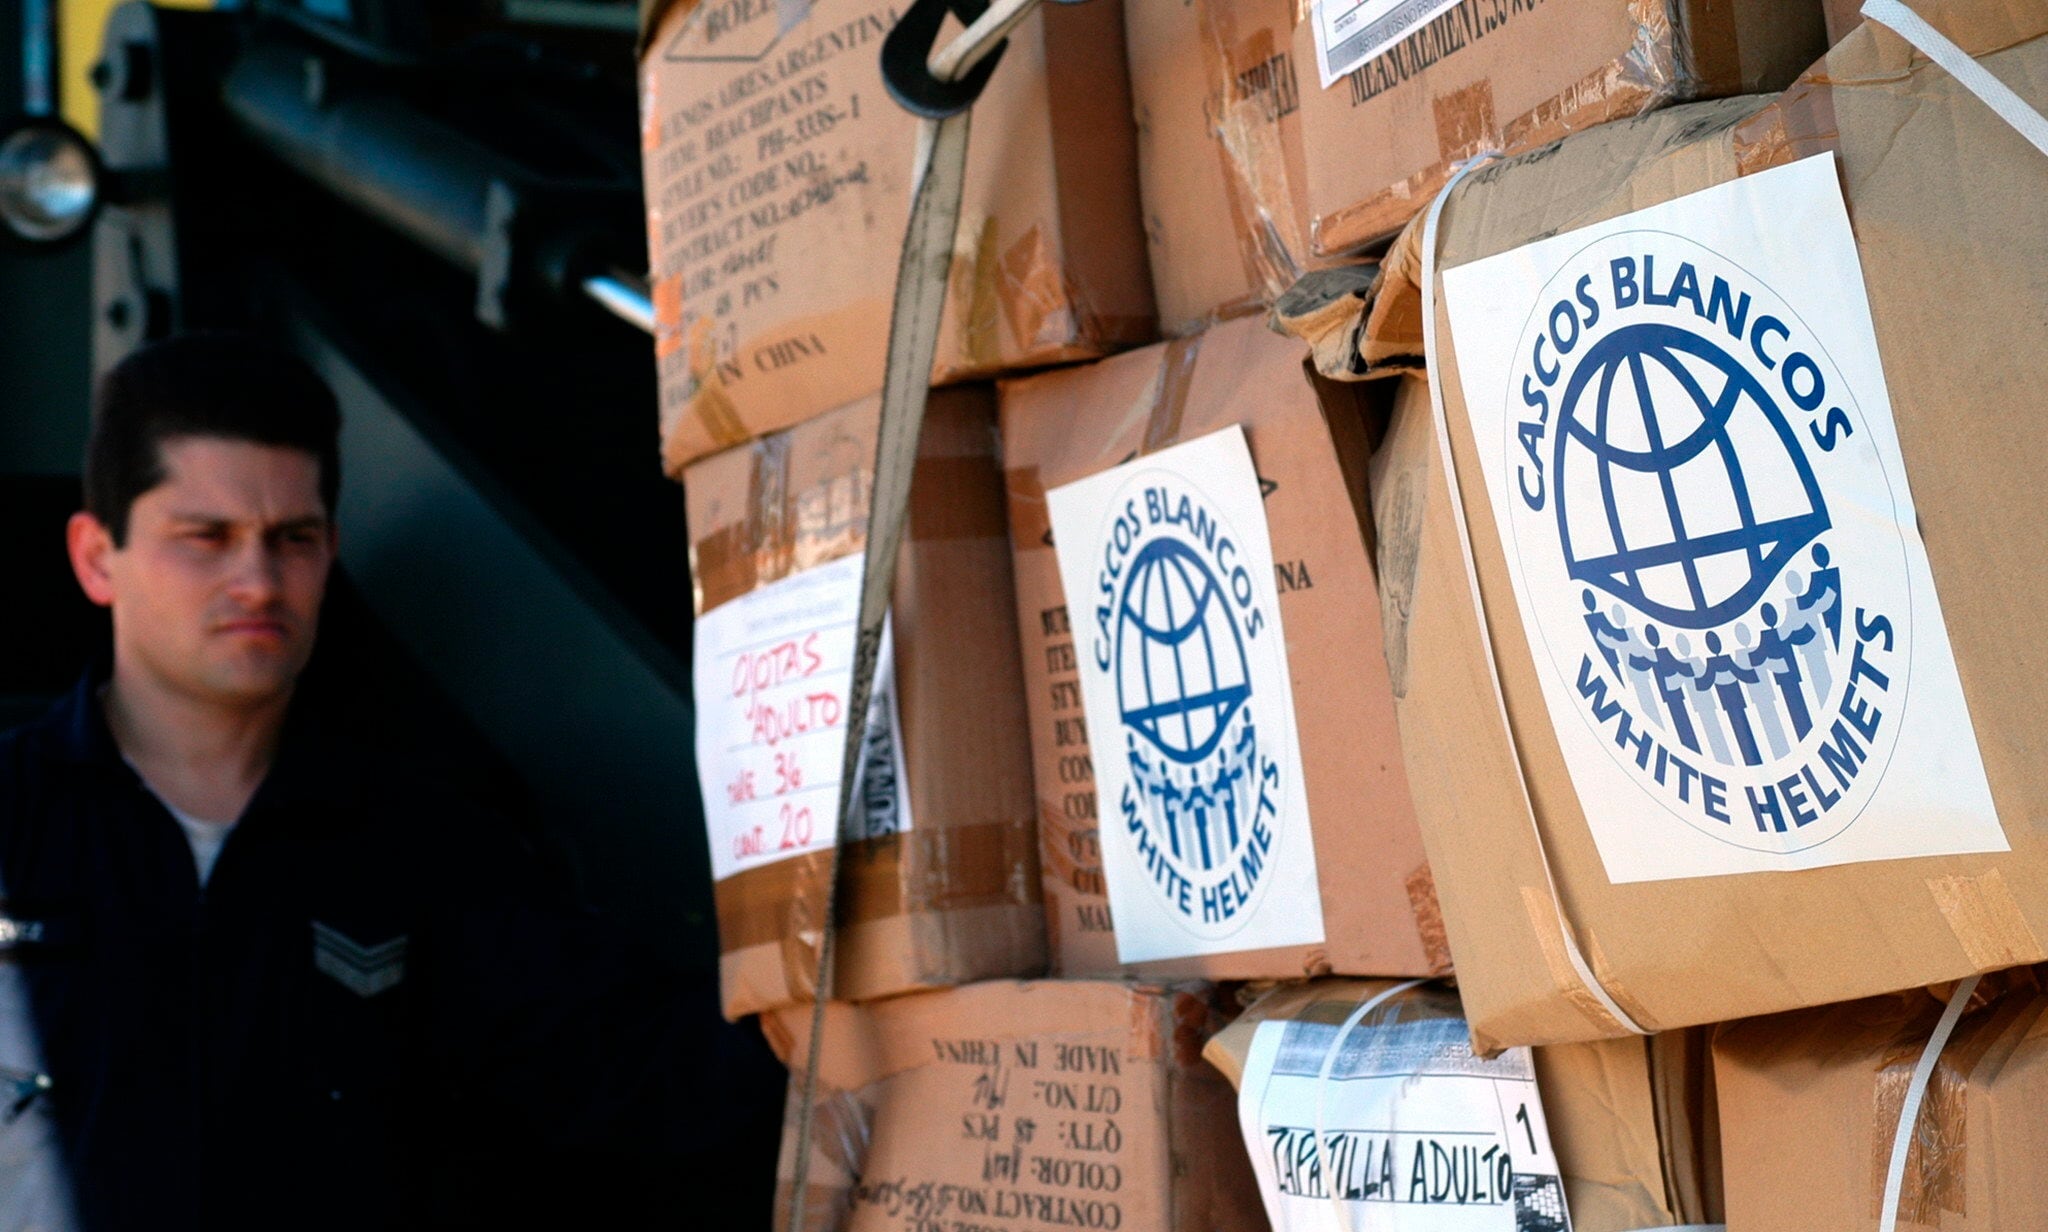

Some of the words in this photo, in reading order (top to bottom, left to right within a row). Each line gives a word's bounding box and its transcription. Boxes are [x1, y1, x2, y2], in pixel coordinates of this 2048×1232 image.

[752, 333, 828, 373] CHINA
[1518, 274, 1601, 512] CASCOS
[1610, 254, 1855, 453] BLANCOS
[1094, 499, 1142, 674] CASCOS
[1143, 486, 1265, 640] BLANCOS
[1576, 652, 1732, 826] WHITE
[1744, 606, 1895, 833] HELMETS
[780, 802, 815, 851] 20
[1119, 782, 1194, 917] WHITE
[1199, 752, 1280, 924] HELMETS
[932, 1038, 1001, 1067] CHINA
[1015, 1041, 1039, 1069] IN
[1054, 1042, 1121, 1076] MADE
[961, 1112, 1000, 1142] PCS
[1515, 1102, 1538, 1155] 1
[1030, 1155, 1123, 1193] COLOR:
[1409, 1135, 1514, 1205] ADULTO
[993, 1189, 1122, 1231] CONTRACT
